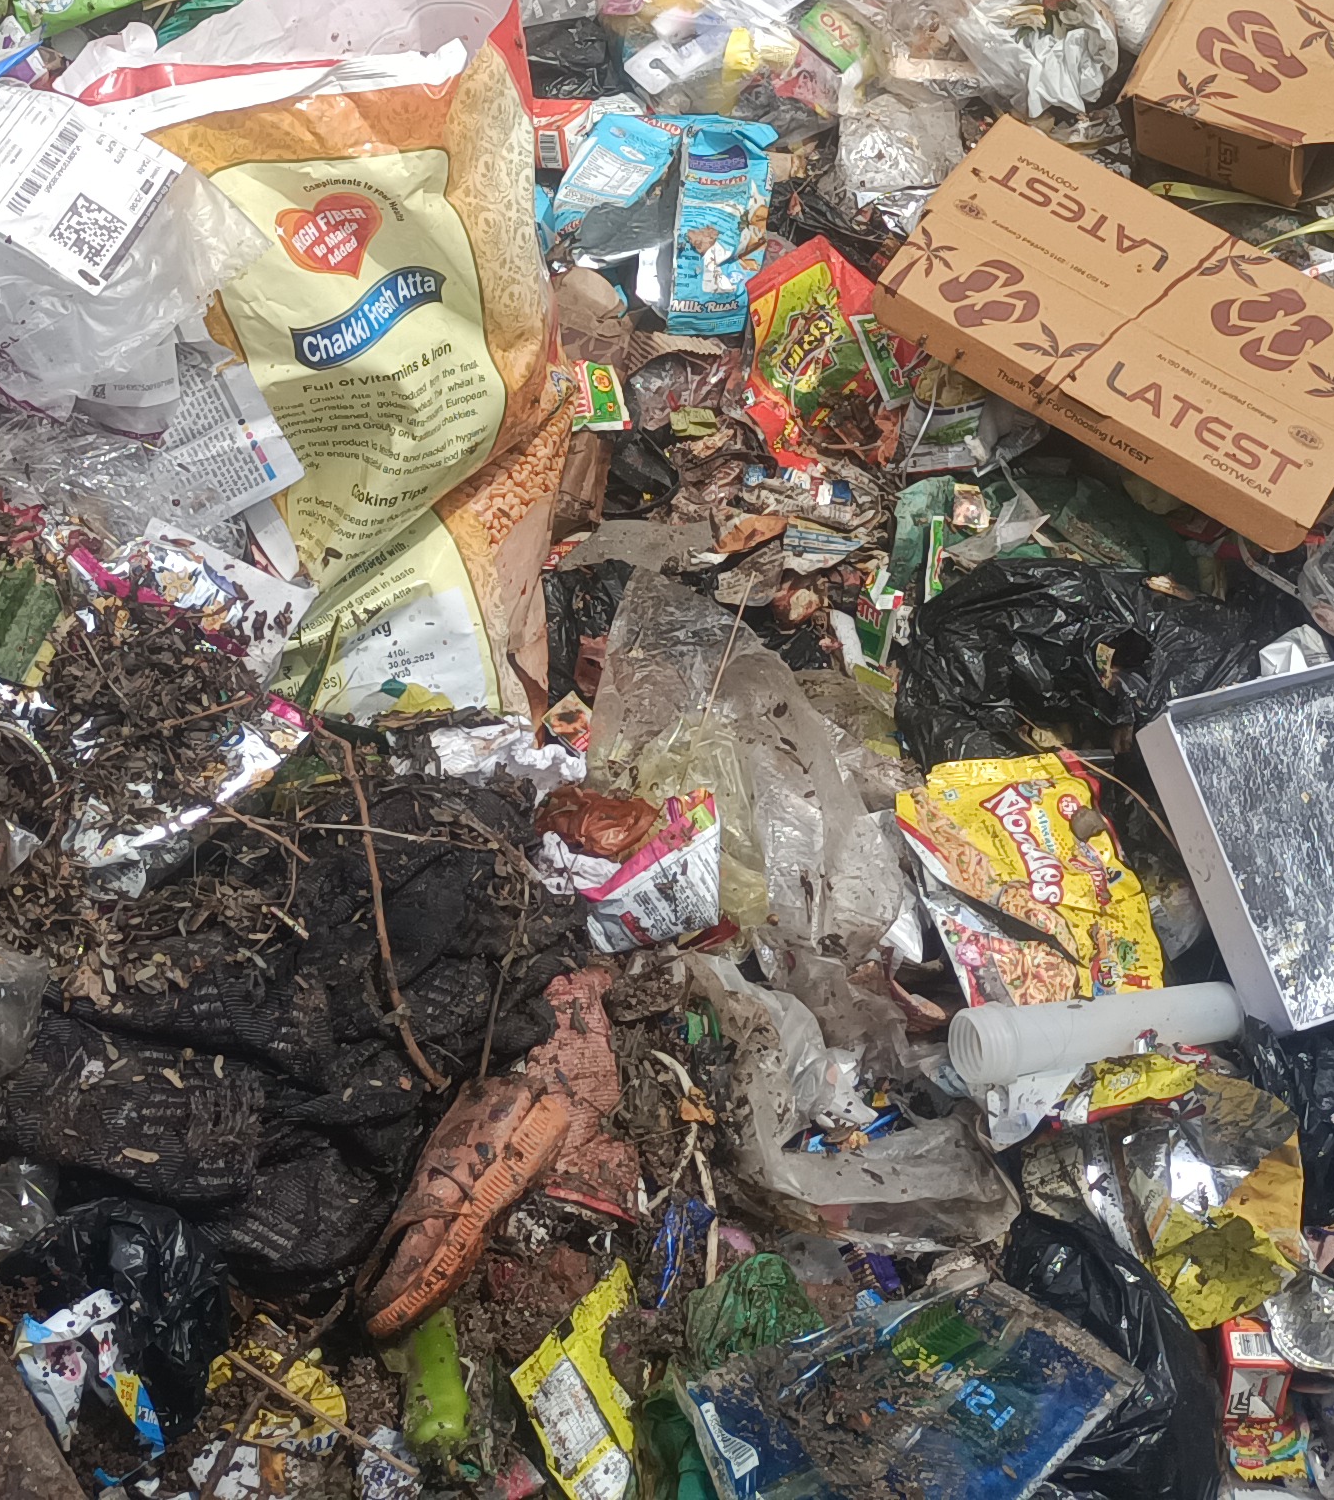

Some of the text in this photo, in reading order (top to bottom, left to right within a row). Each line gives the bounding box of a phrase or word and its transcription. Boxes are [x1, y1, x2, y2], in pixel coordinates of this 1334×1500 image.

[1016, 154, 1080, 192] FOOTWEAR
[313, 220, 360, 259] No Maida
[315, 206, 368, 233] FIBER
[987, 164, 1169, 274] LATEST
[326, 235, 360, 267] Added
[302, 272, 437, 363] Chakki Fresh Atta
[670, 299, 703, 314] Milk
[302, 341, 453, 394] Full of Vitamins & Iron
[996, 367, 1156, 466] Thank You For Choosing LATEST
[1105, 360, 1306, 487] LATEST
[1246, 400, 1280, 425] Company
[351, 482, 430, 508] Cooking Tips
[1202, 453, 1273, 498] FOOTWEAR
[983, 782, 1064, 905] Noodles
